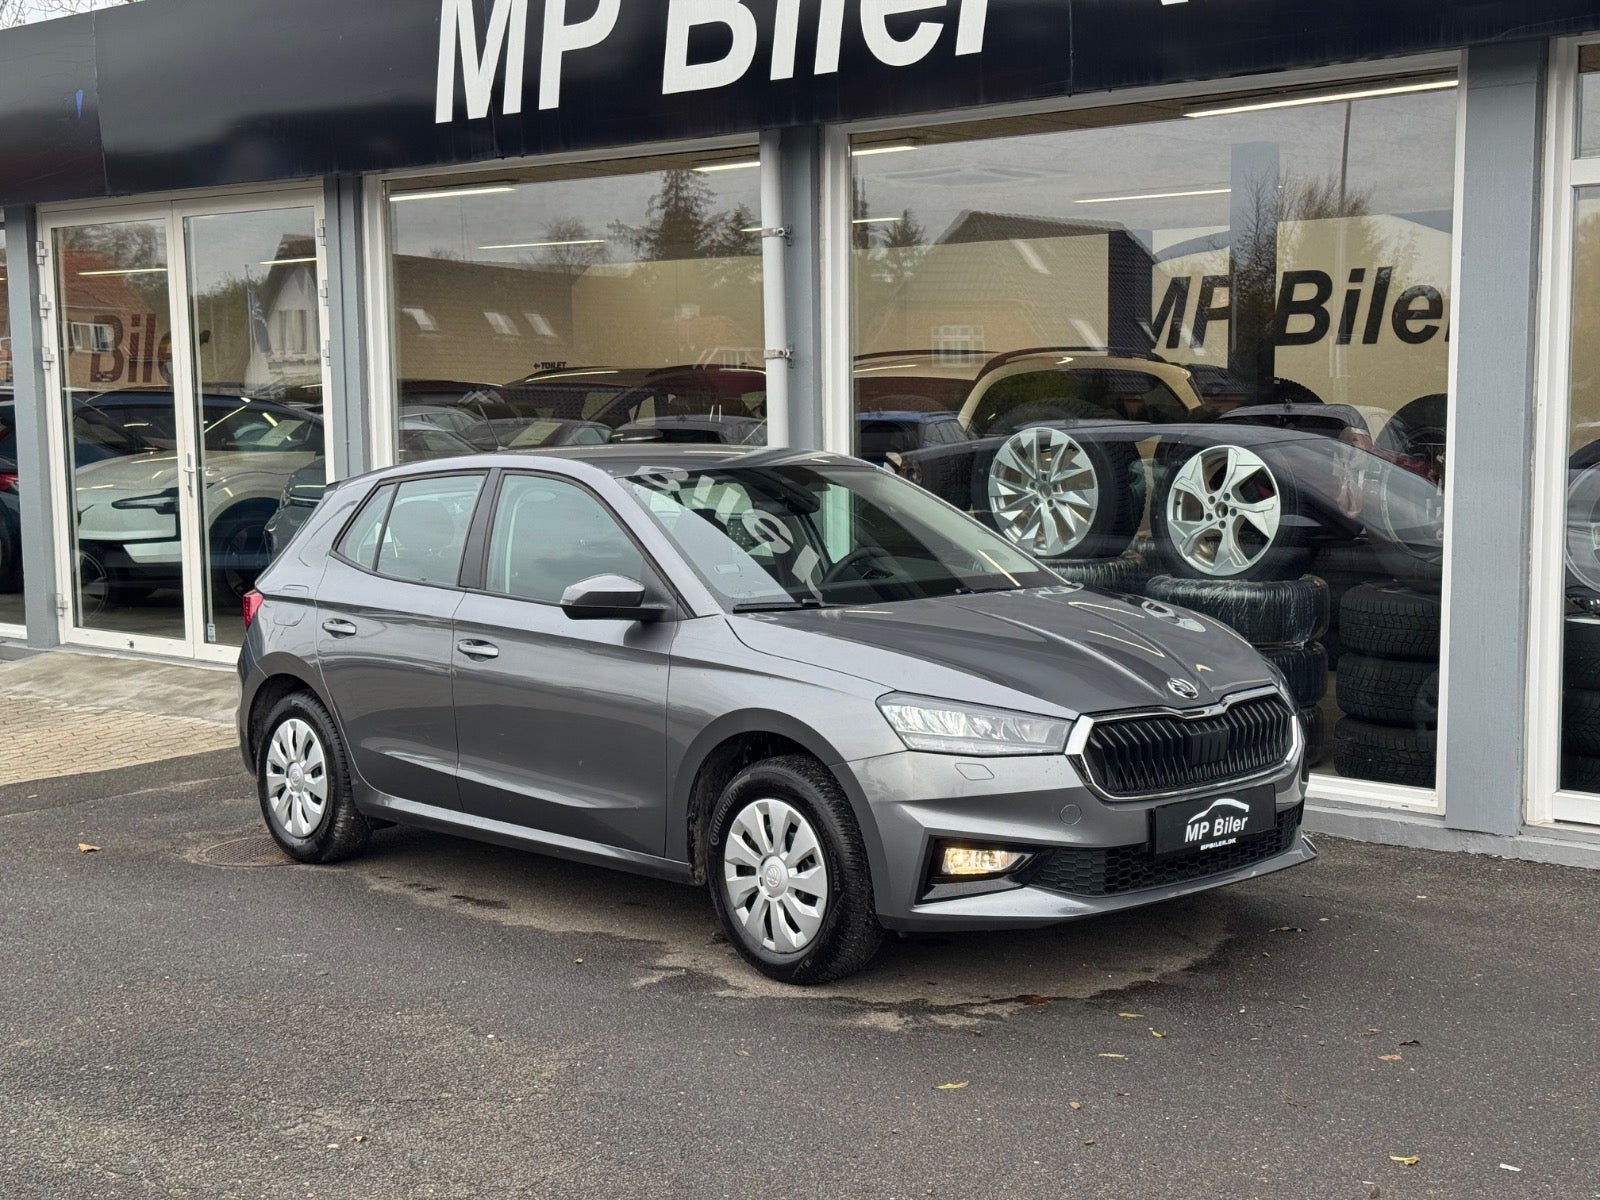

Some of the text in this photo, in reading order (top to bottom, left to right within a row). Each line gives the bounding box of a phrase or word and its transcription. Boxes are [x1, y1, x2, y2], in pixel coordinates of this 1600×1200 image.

[434, 0, 618, 123] MP
[1273, 266, 1449, 346] Bile
[1185, 816, 1248, 842] MP Biler
